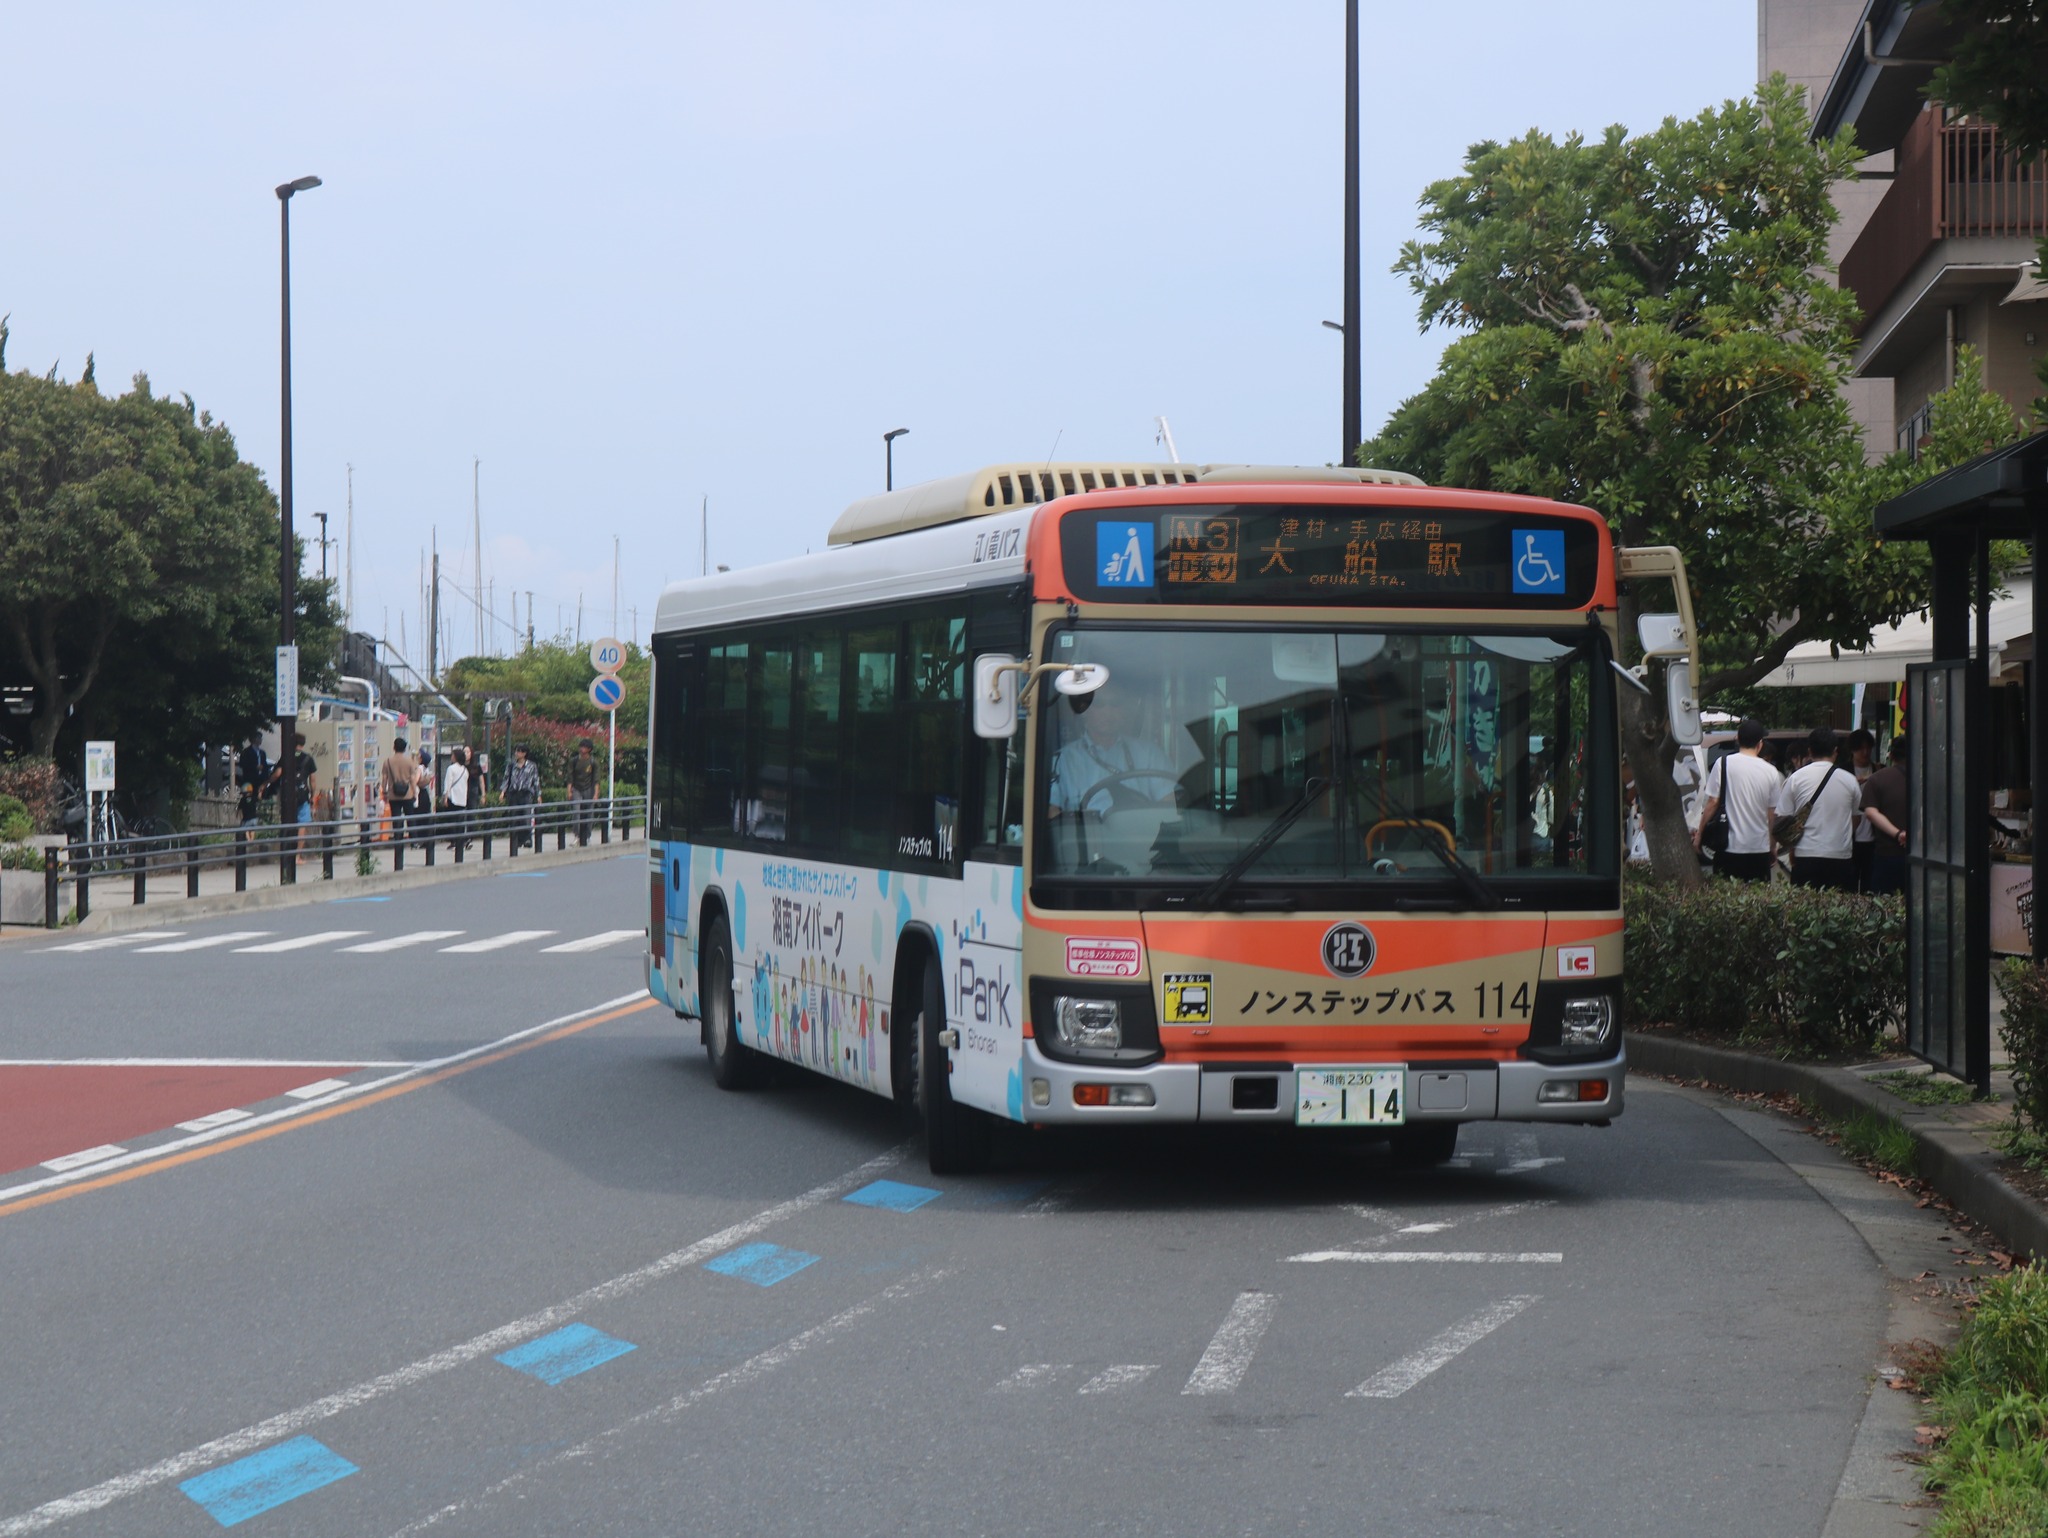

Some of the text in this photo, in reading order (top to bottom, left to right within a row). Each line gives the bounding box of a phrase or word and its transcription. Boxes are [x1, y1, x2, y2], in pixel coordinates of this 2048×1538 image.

[1176, 520, 1230, 551] N3
[1279, 518, 1443, 541] 津村・手広経由
[1258, 537, 1462, 577] 大船駅
[1308, 574, 1360, 586] OFUNA
[599, 647, 619, 664] 40
[898, 824, 953, 861] ノンステップバス 114
[772, 895, 844, 958] 湘南アイパーク
[1240, 981, 1531, 1018] ノンステップバス 114
